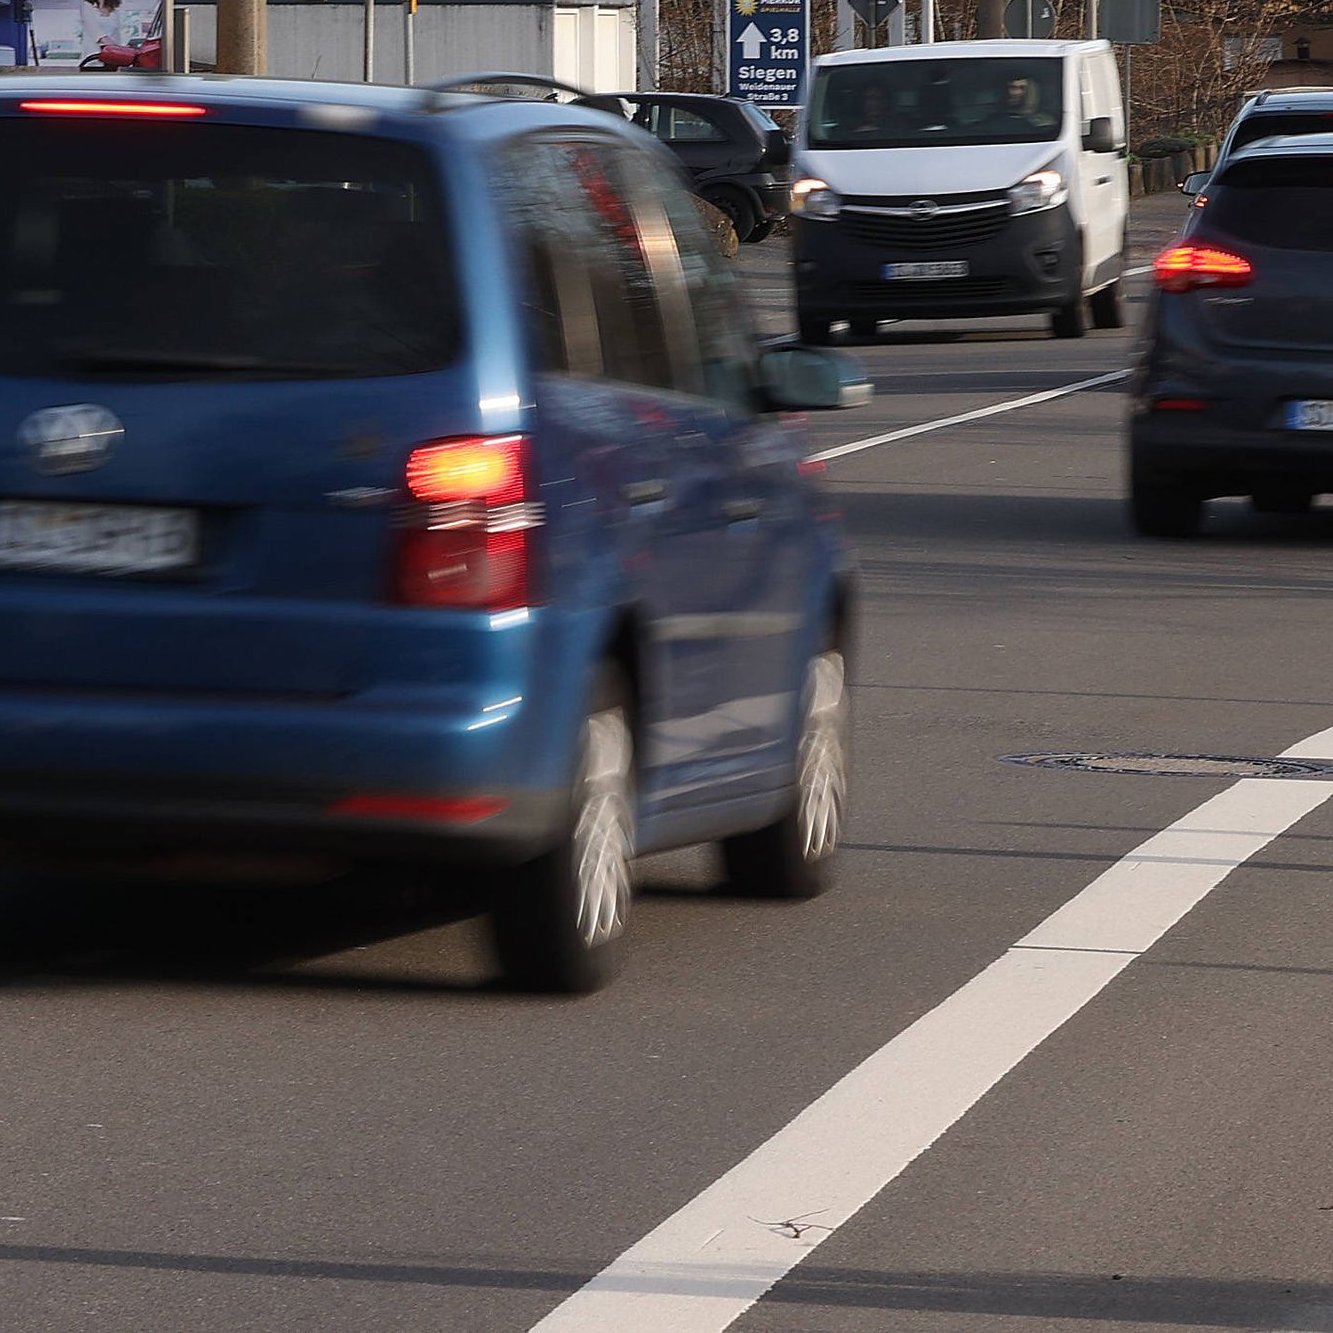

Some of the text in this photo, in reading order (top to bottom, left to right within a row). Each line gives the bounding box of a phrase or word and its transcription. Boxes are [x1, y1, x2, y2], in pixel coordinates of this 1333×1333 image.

[770, 28, 800, 45] 3,8
[771, 45, 799, 59] km
[738, 66, 797, 82] Siegen
[738, 82, 797, 91] Weidenauer
